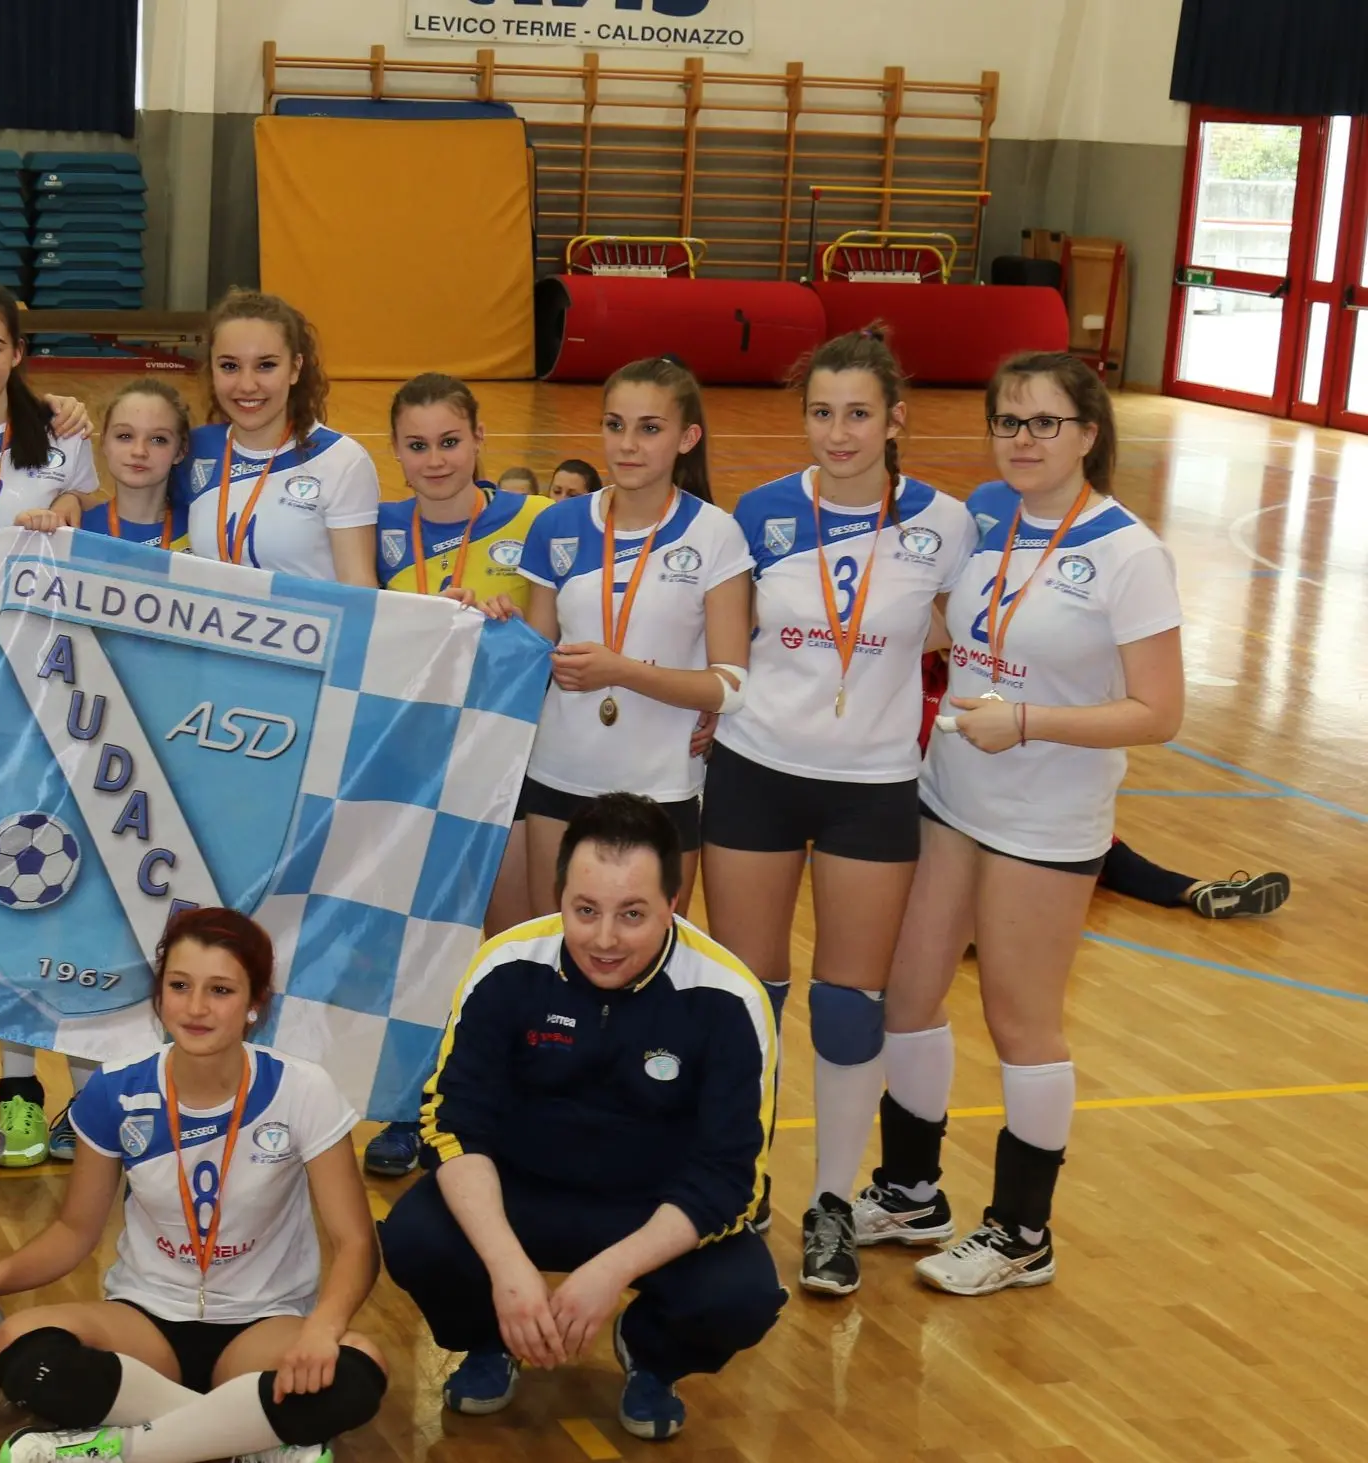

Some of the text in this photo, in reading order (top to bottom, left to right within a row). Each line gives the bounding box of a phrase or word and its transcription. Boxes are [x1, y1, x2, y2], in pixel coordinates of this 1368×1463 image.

[413, 14, 496, 35] LEVICO
[502, 19, 577, 39] TERME
[597, 24, 745, 46] CALDONAZZO
[13, 568, 322, 656] CALDONAZZO
[833, 555, 859, 623] 3
[164, 700, 298, 761] ASD
[38, 956, 121, 991] 1967
[192, 1160, 220, 1238] 8
